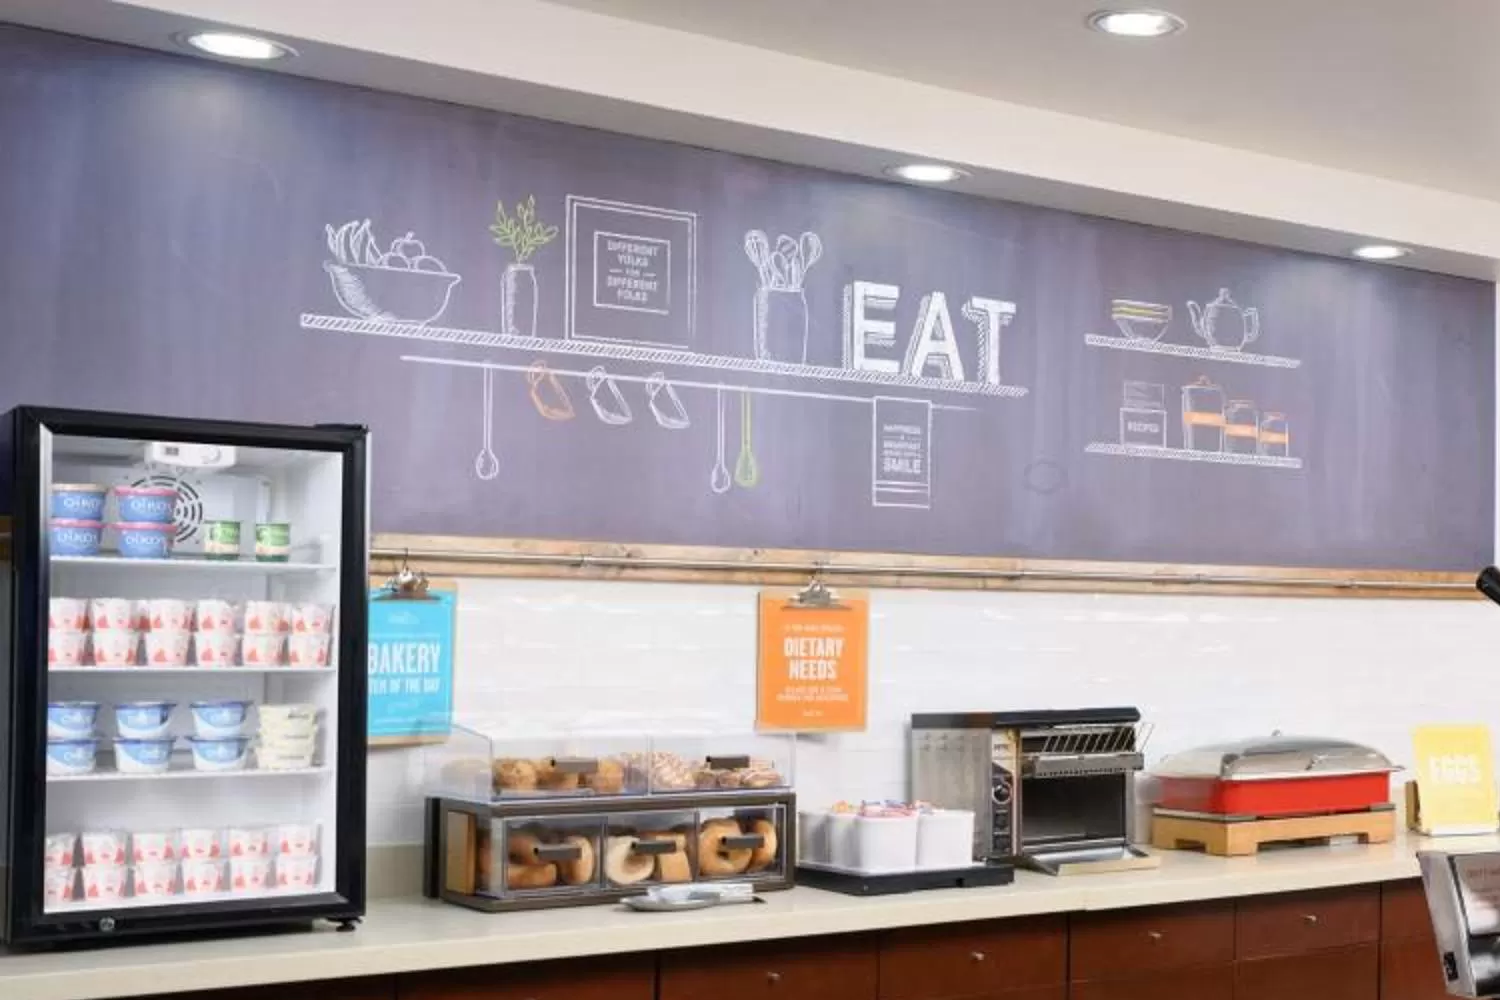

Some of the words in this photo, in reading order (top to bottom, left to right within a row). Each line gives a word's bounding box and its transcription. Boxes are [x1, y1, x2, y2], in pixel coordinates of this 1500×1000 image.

[843, 280, 1016, 385] EAT
[882, 457, 921, 474] SMILE
[367, 641, 441, 674] BAKERY
[783, 637, 846, 657] DIETARY
[788, 659, 838, 681] NEEDS
